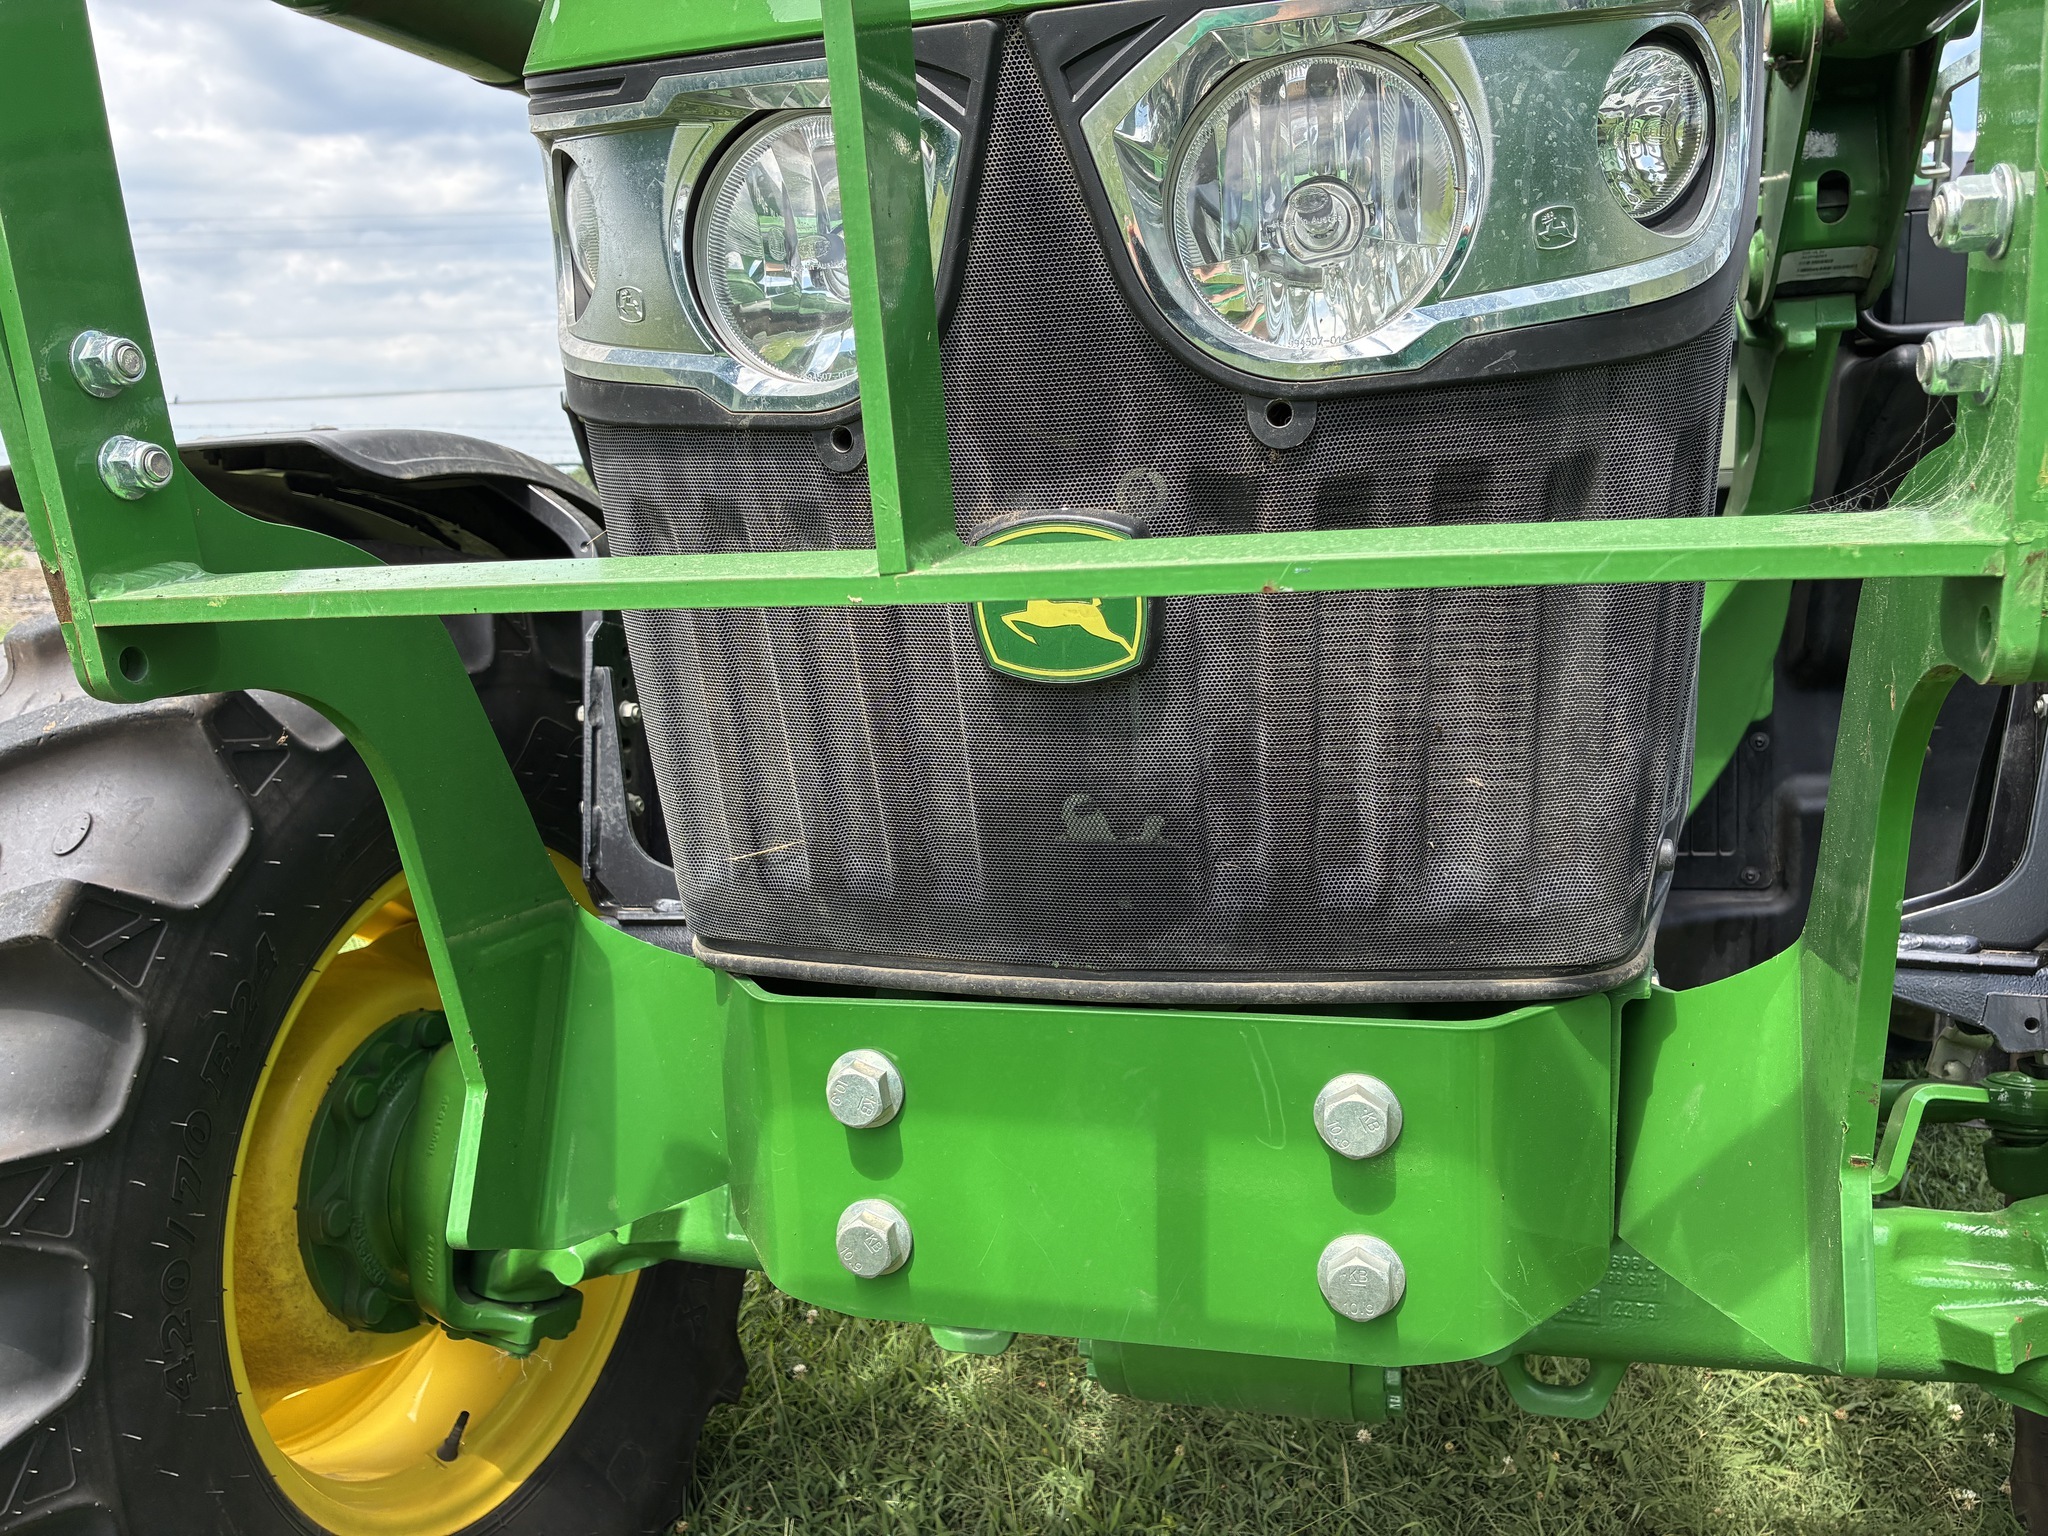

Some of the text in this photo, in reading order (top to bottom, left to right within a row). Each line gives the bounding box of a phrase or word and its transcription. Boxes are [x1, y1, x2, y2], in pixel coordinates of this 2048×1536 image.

[830, 1080, 849, 1107] 10.9
[1361, 1111, 1381, 1133] KB
[1327, 1121, 1350, 1150] 10.9
[160, 1108, 214, 1402] 420/70
[865, 1234, 884, 1253] KB
[840, 1246, 863, 1272] 10.9
[1347, 1268, 1369, 1284] KB
[1343, 1302, 1375, 1317] 10.9
